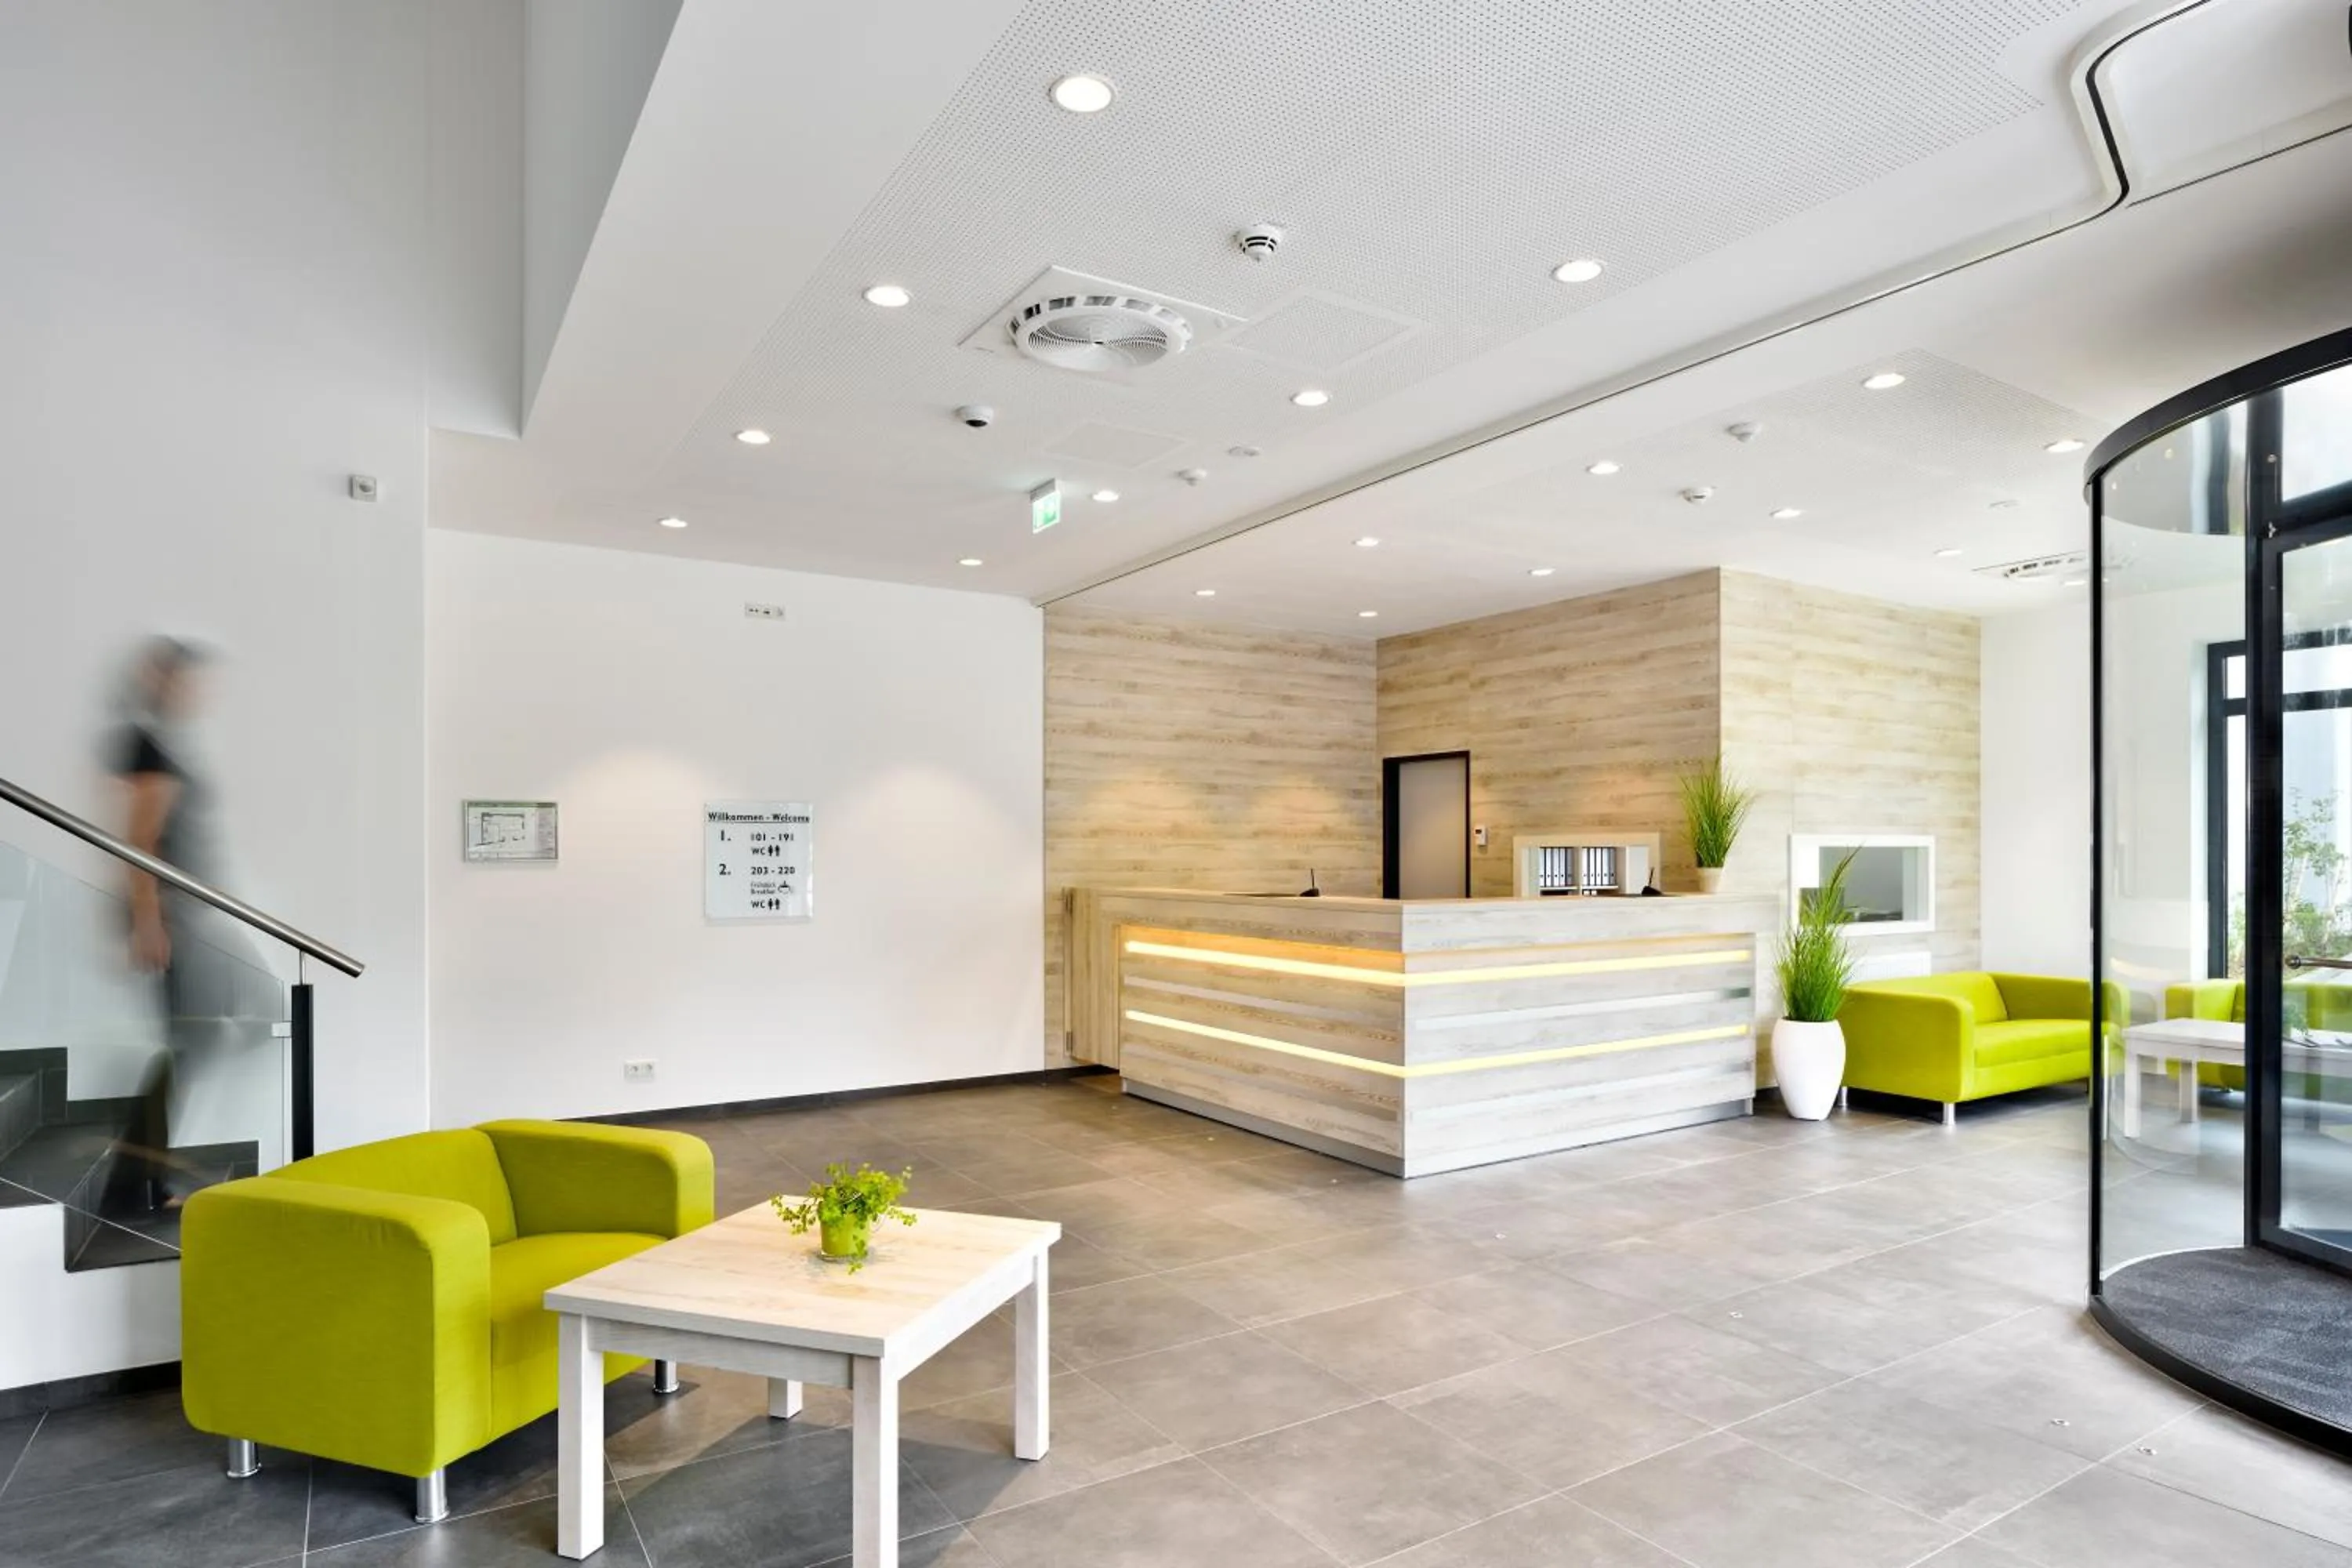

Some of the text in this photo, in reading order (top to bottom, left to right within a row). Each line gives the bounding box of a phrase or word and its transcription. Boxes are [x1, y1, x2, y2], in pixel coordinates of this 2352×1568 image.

[751, 847, 766, 855] WC
[719, 863, 731, 876] 2.
[751, 866, 768, 875] 203
[751, 900, 766, 909] WC
